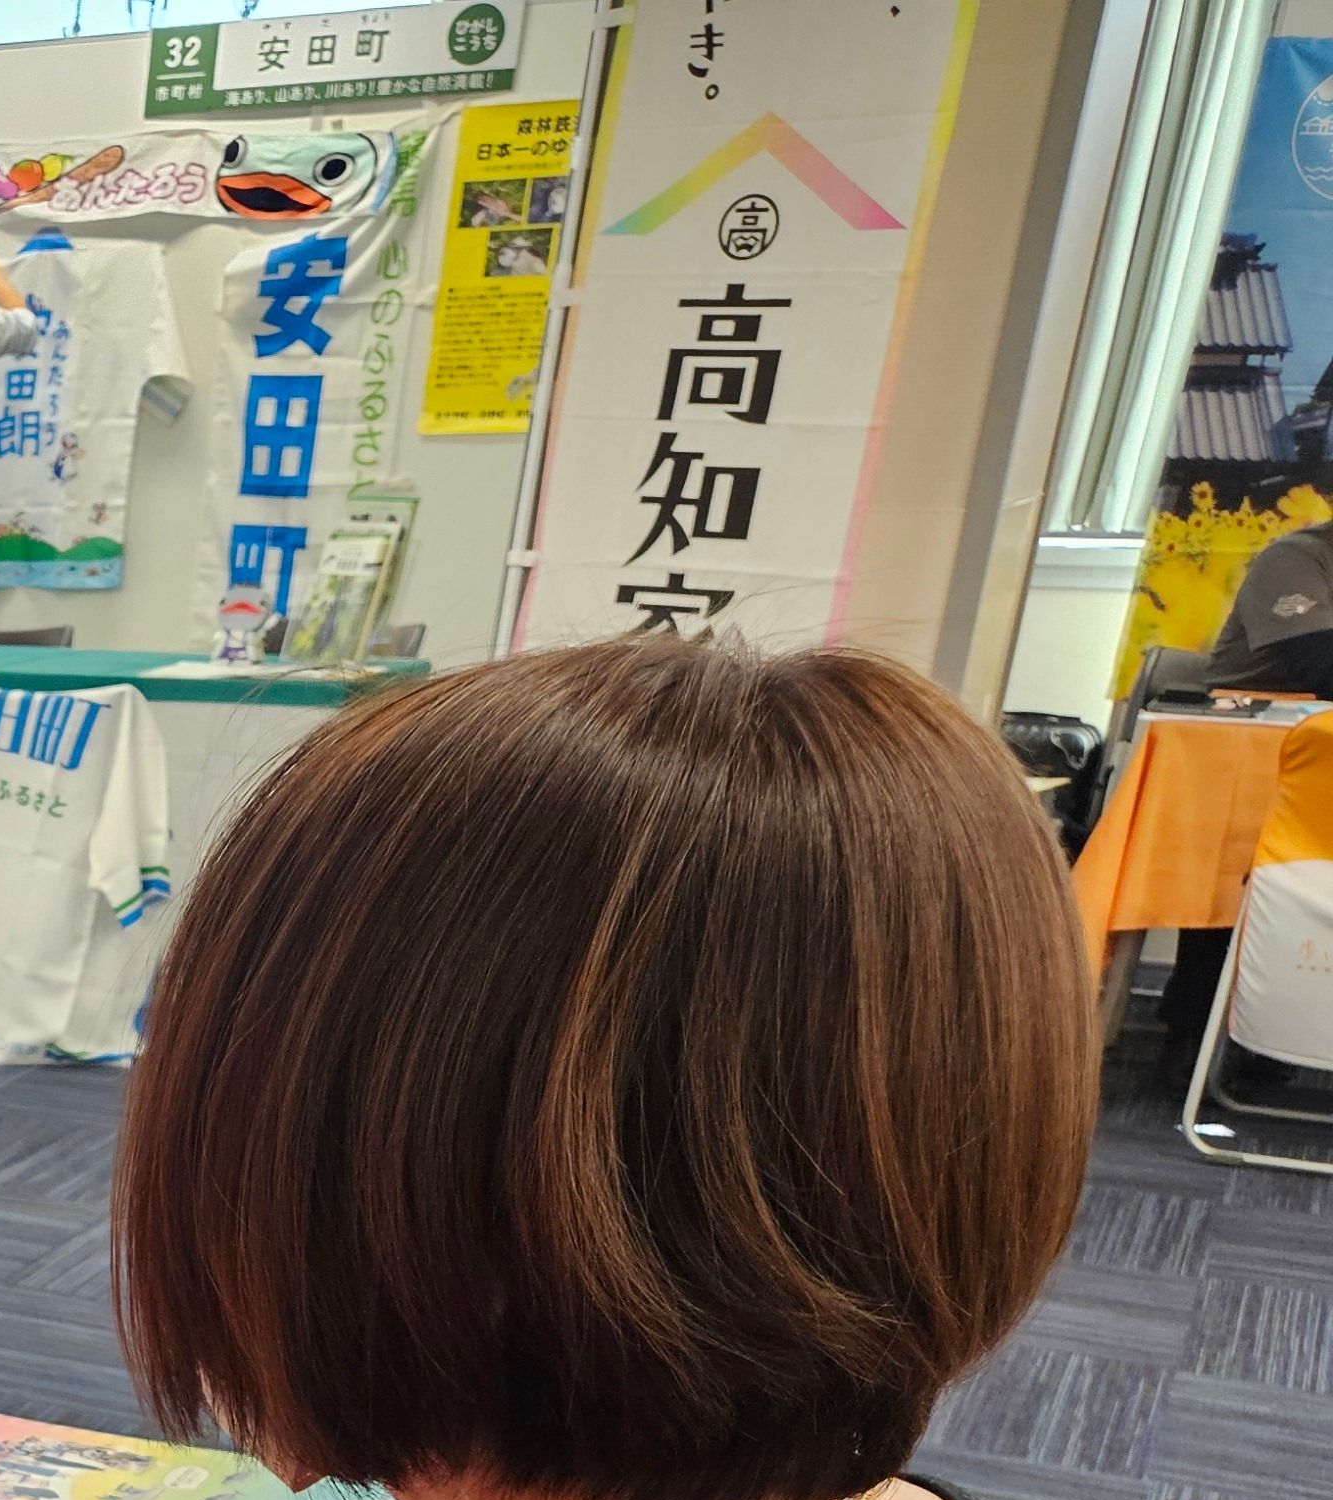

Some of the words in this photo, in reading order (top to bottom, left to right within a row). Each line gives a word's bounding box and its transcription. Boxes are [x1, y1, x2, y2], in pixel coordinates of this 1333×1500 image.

[453, 34, 498, 52] こうち
[455, 17, 497, 35] ひがし
[164, 36, 201, 68] 32
[258, 30, 391, 73] 安田町
[47, 162, 209, 212] あんたろう
[225, 231, 350, 618] 安田町
